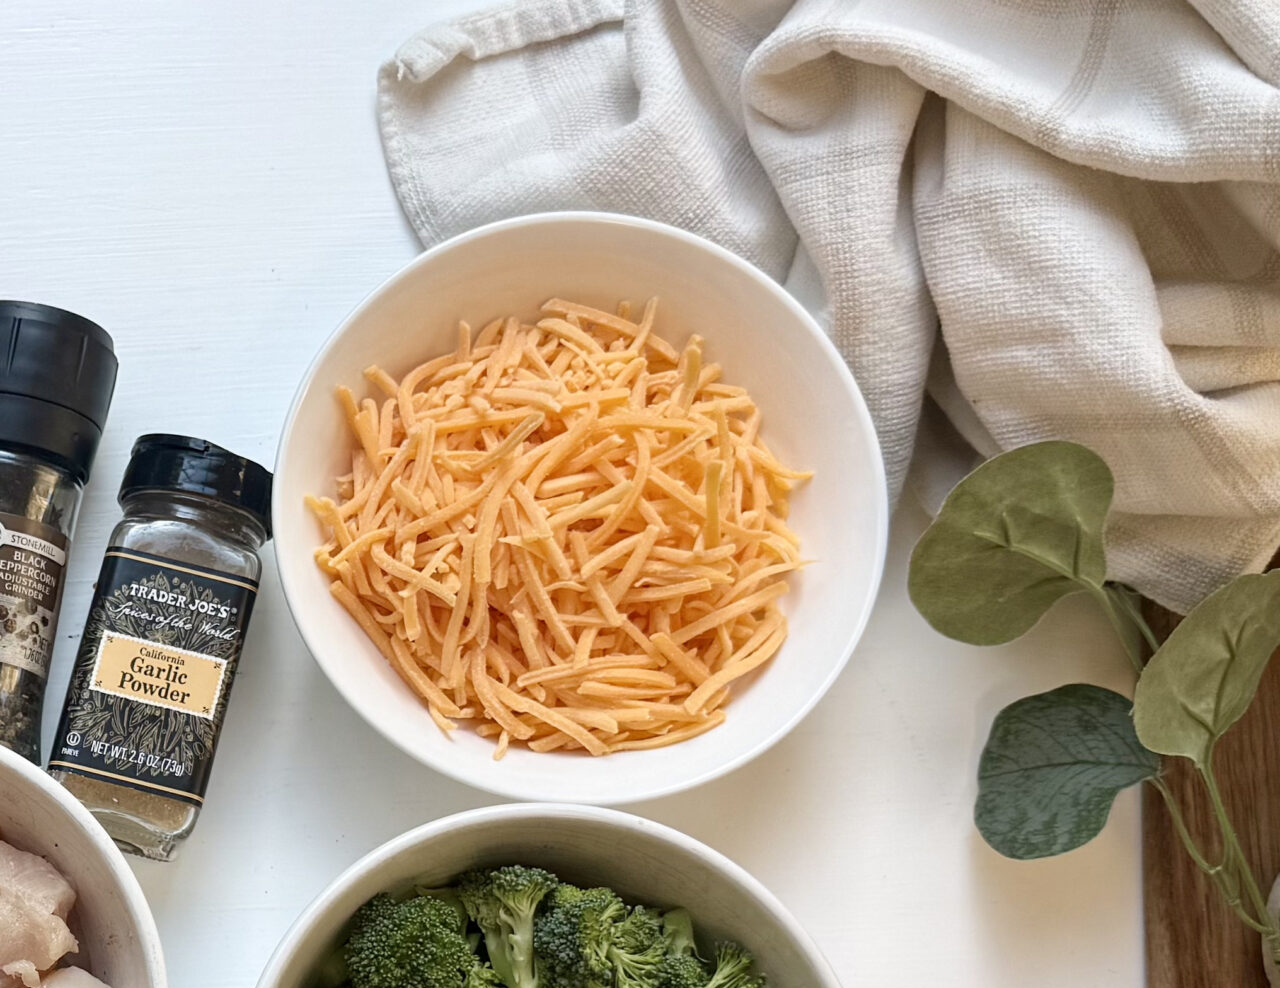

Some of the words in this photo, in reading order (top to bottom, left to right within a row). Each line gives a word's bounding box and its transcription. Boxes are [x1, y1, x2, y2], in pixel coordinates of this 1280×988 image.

[11, 534, 55, 557] STONEMILL
[14, 551, 47, 570] BLACK
[5, 583, 44, 600] GRINDER
[130, 584, 186, 608] TRADER
[189, 600, 230, 618] JOE'S
[109, 601, 155, 620] Spices
[155, 614, 172, 629] of
[170, 614, 192, 630] the
[199, 621, 240, 640] World
[130, 656, 187, 686] Garlic
[139, 646, 185, 667] California
[118, 671, 190, 704] Powder
[91, 741, 109, 755] NET
[111, 745, 127, 760] WT.
[129, 750, 145, 764] 2.6
[146, 754, 160, 768] OZ
[160, 758, 185, 776] (73g)
